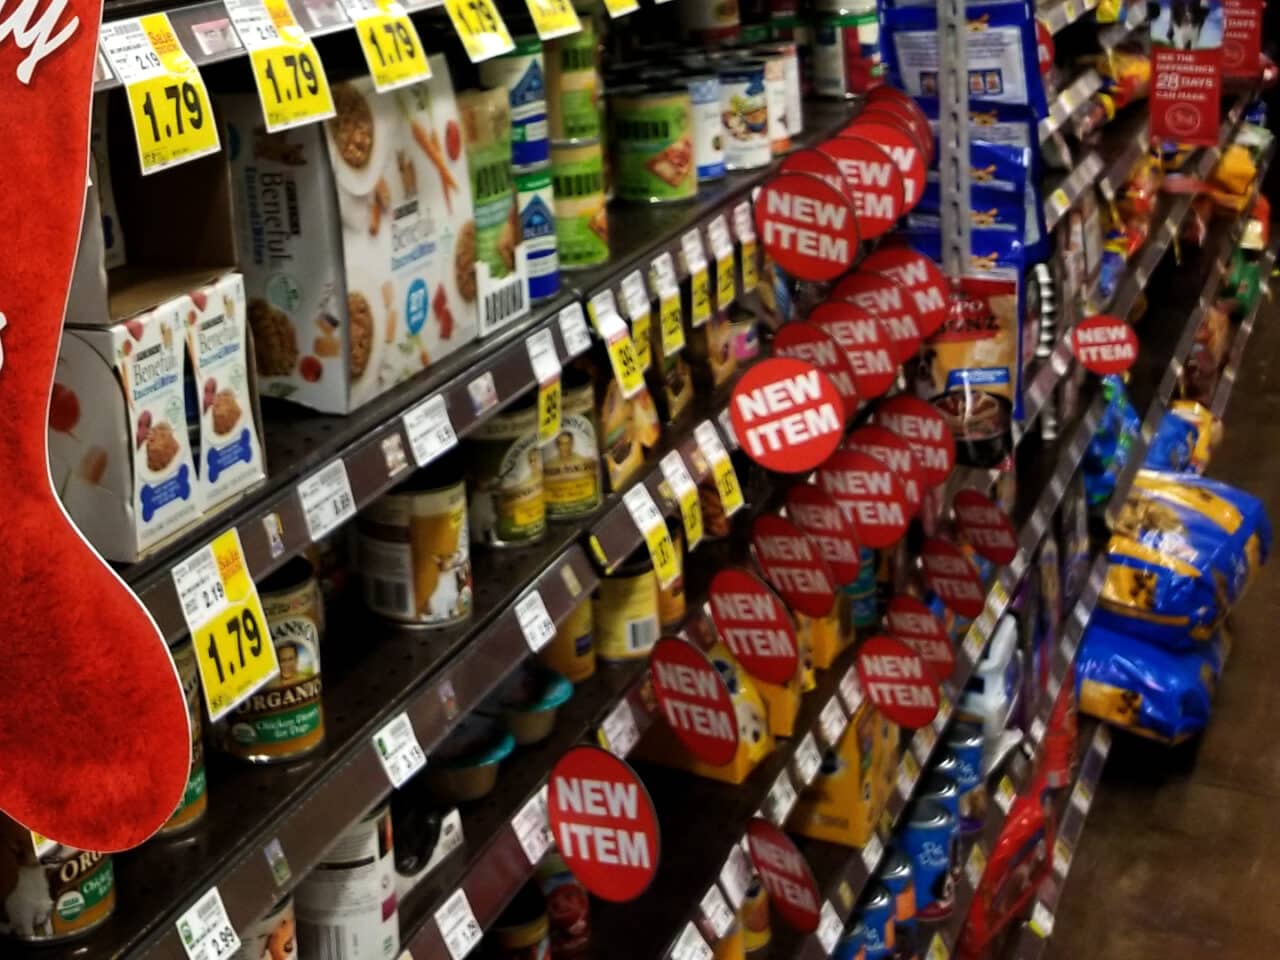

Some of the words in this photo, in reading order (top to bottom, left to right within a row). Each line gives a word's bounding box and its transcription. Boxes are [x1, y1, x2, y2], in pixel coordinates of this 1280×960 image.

[369, 20, 417, 70] 1.79
[265, 52, 320, 104] 1.79
[143, 81, 204, 143] 1.79
[766, 189, 847, 231] NEW
[762, 220, 849, 264] ITEM
[1076, 325, 1129, 342] NEW
[1079, 343, 1135, 362] ITEM
[735, 369, 822, 423] NEW
[745, 403, 841, 457] ITEM
[822, 469, 893, 496] NEW
[755, 534, 813, 561] NEW
[768, 566, 831, 596] ITEM
[710, 593, 776, 621] NEW
[208, 607, 262, 684] 1.79
[722, 628, 796, 658] ITEM
[652, 660, 720, 701] NEW
[861, 653, 923, 679] NEW
[866, 682, 937, 708] ITEM
[661, 699, 737, 742] ITEM
[554, 775, 638, 820] NEW
[556, 821, 651, 870] ITEM
